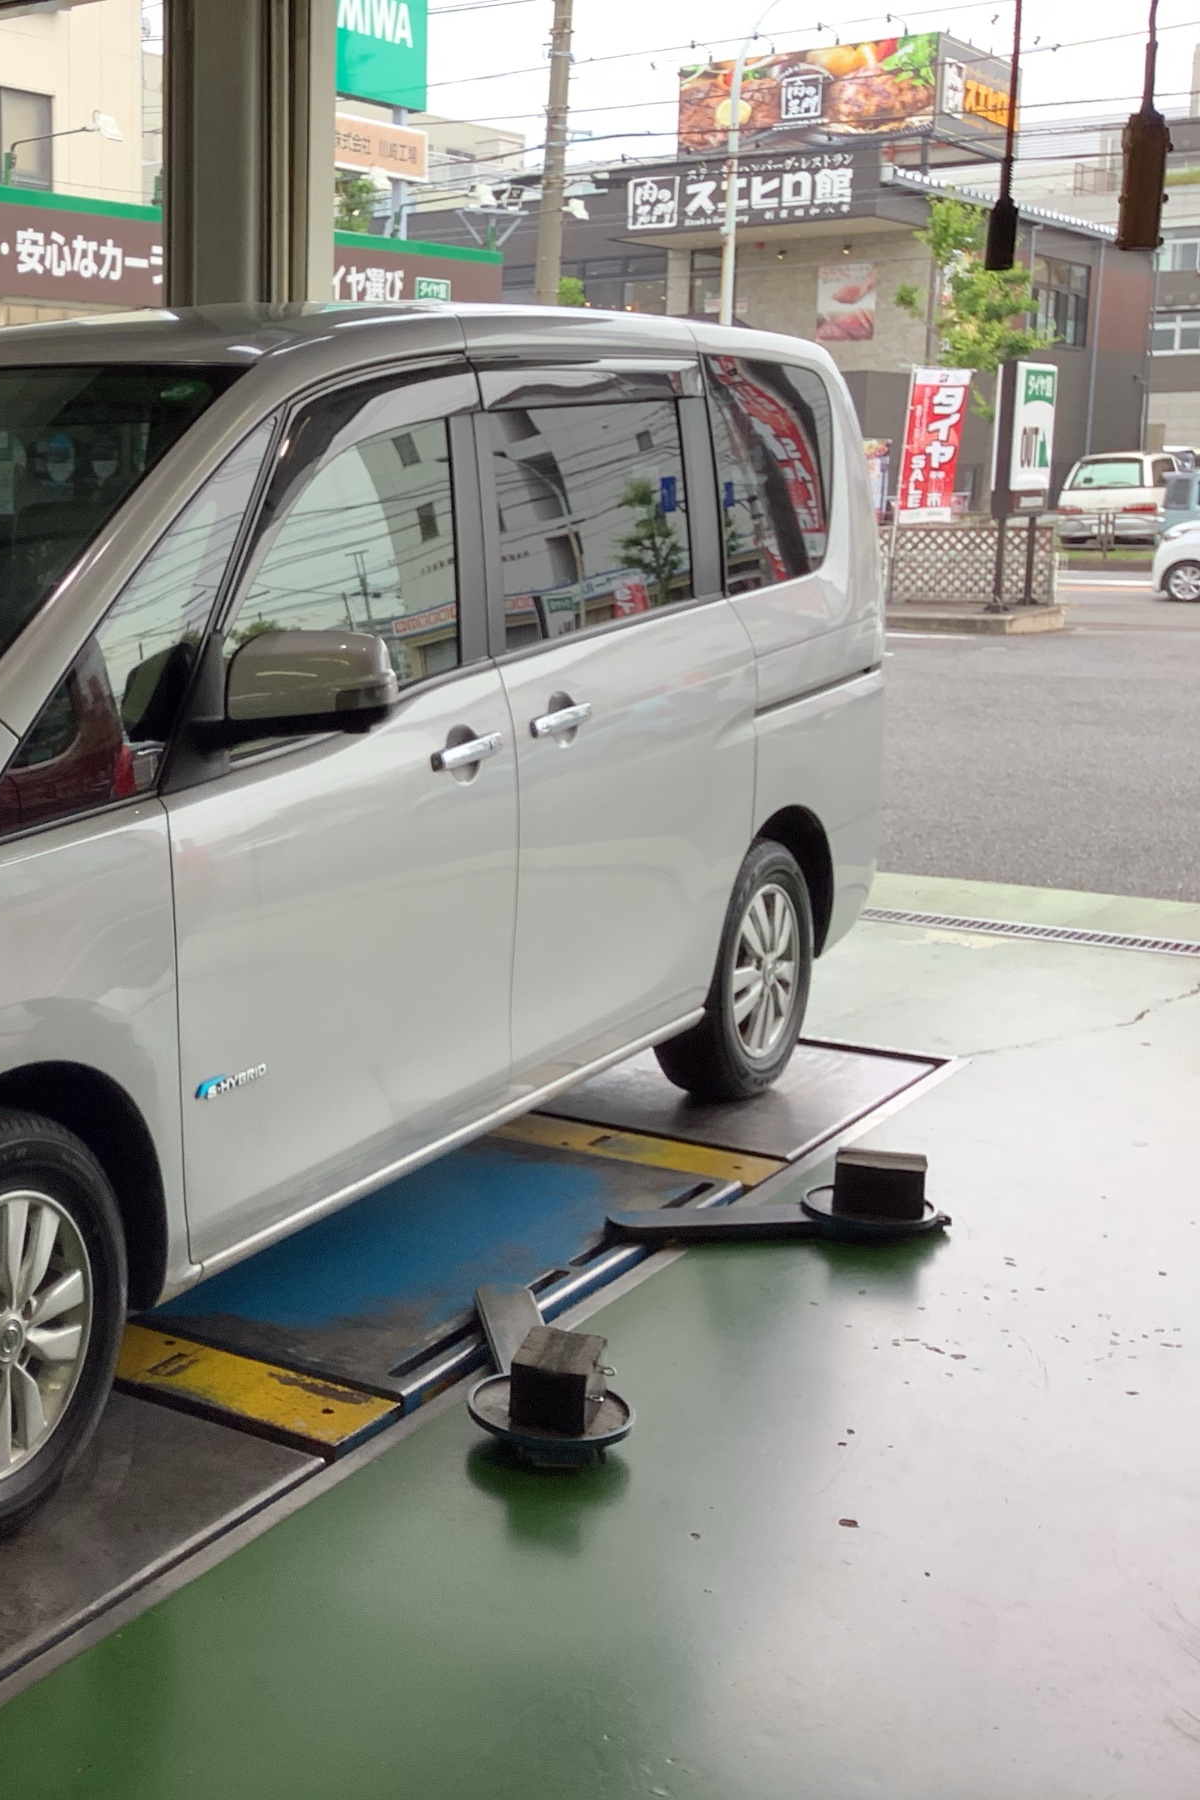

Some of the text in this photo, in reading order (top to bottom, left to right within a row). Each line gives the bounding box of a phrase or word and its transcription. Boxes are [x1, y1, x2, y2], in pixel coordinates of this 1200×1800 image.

[925, 386, 965, 468] タイヤ
[907, 454, 927, 508] SALE
